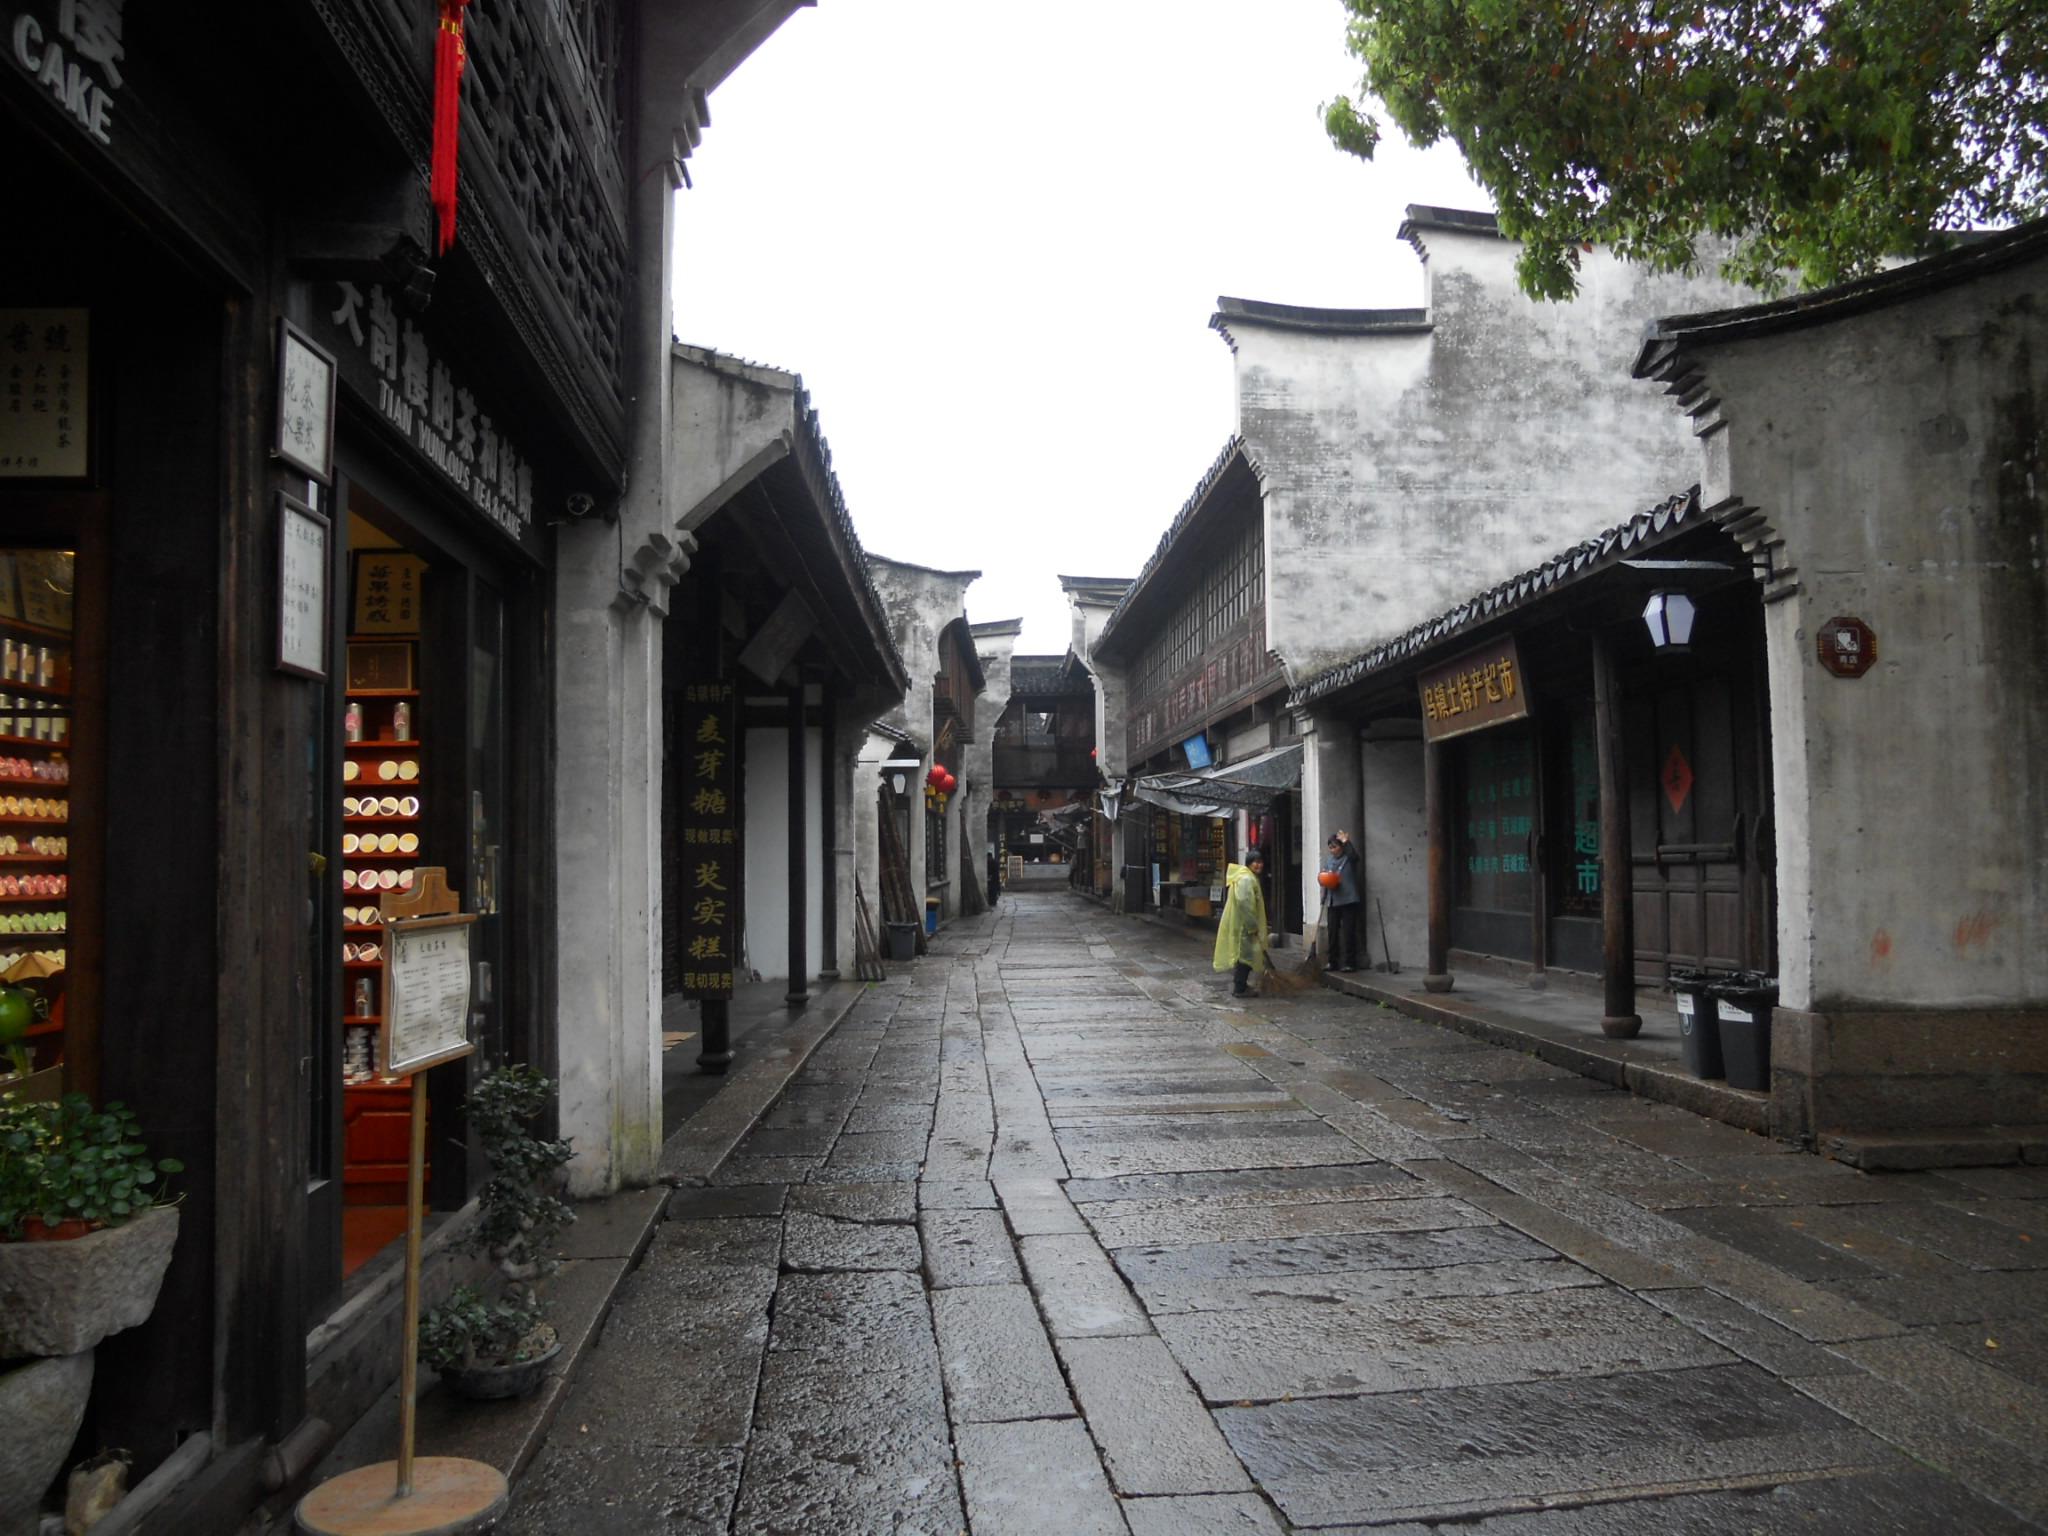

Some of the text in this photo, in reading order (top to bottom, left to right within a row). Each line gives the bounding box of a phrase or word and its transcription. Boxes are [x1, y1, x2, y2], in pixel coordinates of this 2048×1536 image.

[13, 14, 115, 145] CAKE
[379, 378, 413, 436] TIAN
[1424, 655, 1516, 721] 乌镇土特产超市
[690, 713, 727, 816] 麦芽糖
[688, 860, 727, 961] 芡实糕
